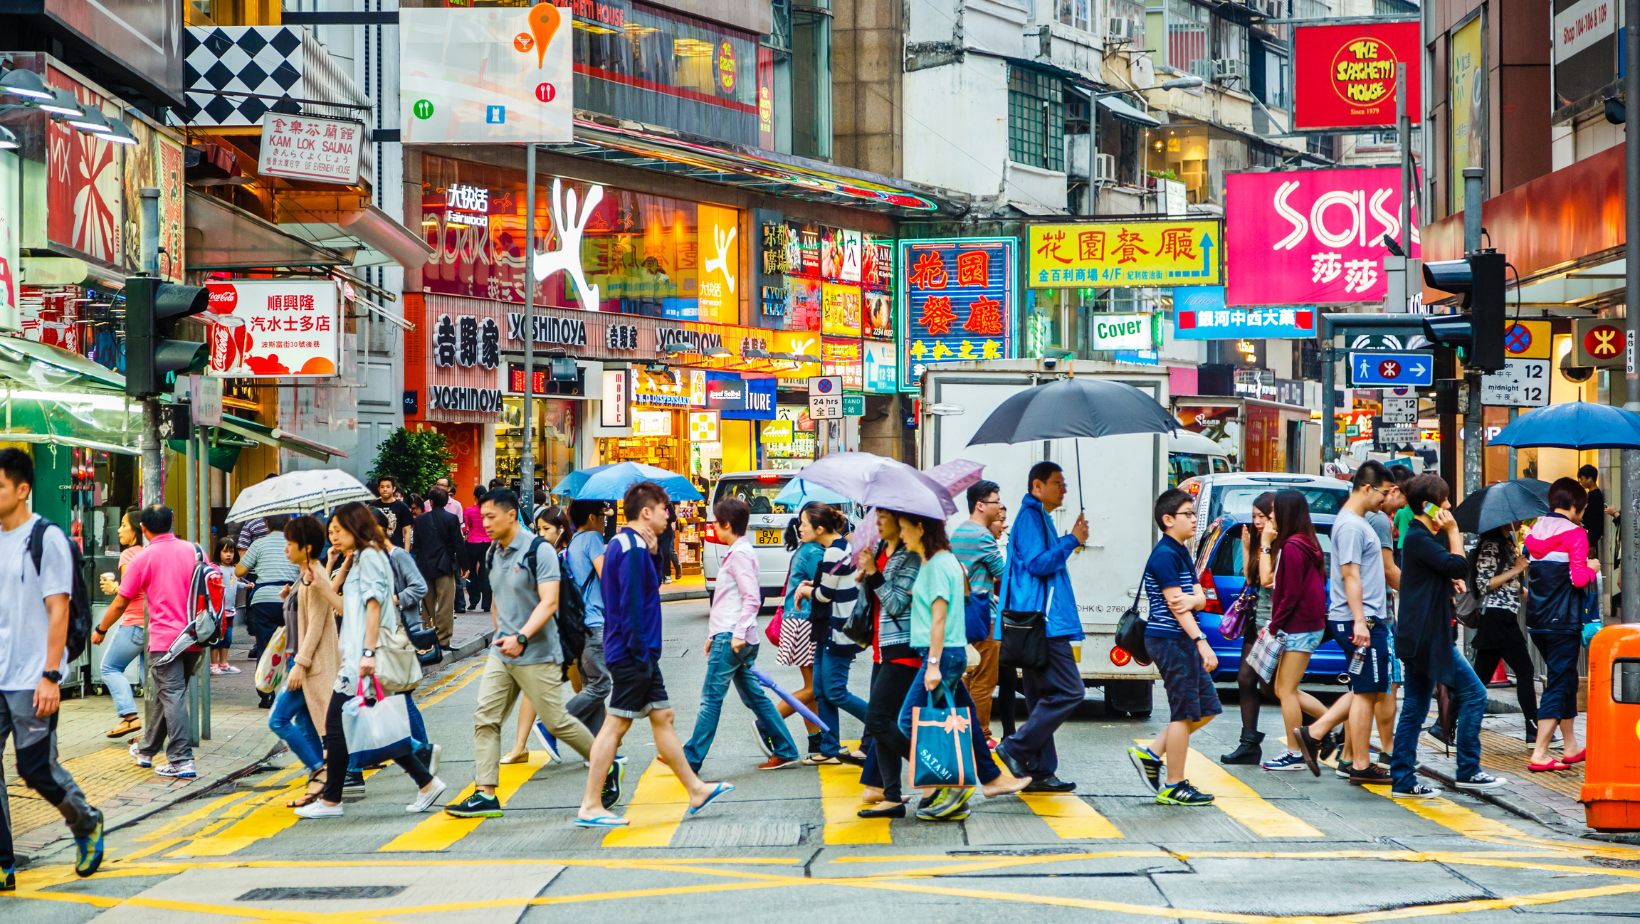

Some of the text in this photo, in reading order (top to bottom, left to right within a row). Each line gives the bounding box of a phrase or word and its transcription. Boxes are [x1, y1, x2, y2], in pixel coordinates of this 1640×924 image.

[597, 3, 624, 27] HOUSE
[1564, 26, 1575, 45] Shop
[1594, 8, 1598, 28] &
[1598, 2, 1607, 24] 109
[1348, 41, 1379, 60] THE
[1347, 81, 1386, 102] HOUSE
[272, 118, 355, 140] 金樂芬蘭館
[269, 134, 353, 155] KAM LOK SAUNA
[336, 165, 351, 175] HOUSE
[448, 184, 488, 212] 大快活
[446, 210, 488, 227] Fairwood
[804, 236, 818, 250] ANA
[1037, 228, 1198, 264] 花園餐廳
[910, 250, 990, 290] 花園
[1038, 268, 1098, 282] 金百利商場
[1102, 268, 1122, 280] 4/F
[1311, 252, 1378, 294] 莎莎
[700, 281, 722, 298] 大快活
[762, 286, 788, 300] KYOTO
[268, 294, 314, 311] 順興隆
[762, 302, 788, 316] PLAZA
[250, 315, 330, 332] 汽水士多店
[918, 294, 1003, 335] 餐廳
[1198, 309, 1311, 328] 銀河中西大藥
[606, 324, 638, 350] 吉野家
[1098, 320, 1142, 340] Cover
[434, 314, 500, 370] 吉野家
[910, 339, 1002, 360] 牛扒之家
[1525, 365, 1543, 378] 12
[430, 386, 504, 412] YOSHINOYA
[652, 394, 690, 405] DISPENSARY
[1524, 388, 1542, 400] 12
[816, 407, 836, 416] 全日
[1404, 400, 1416, 408] 12
[1404, 413, 1416, 422] 12
[762, 426, 790, 435] Clarks
[920, 750, 952, 780] SATAMI
